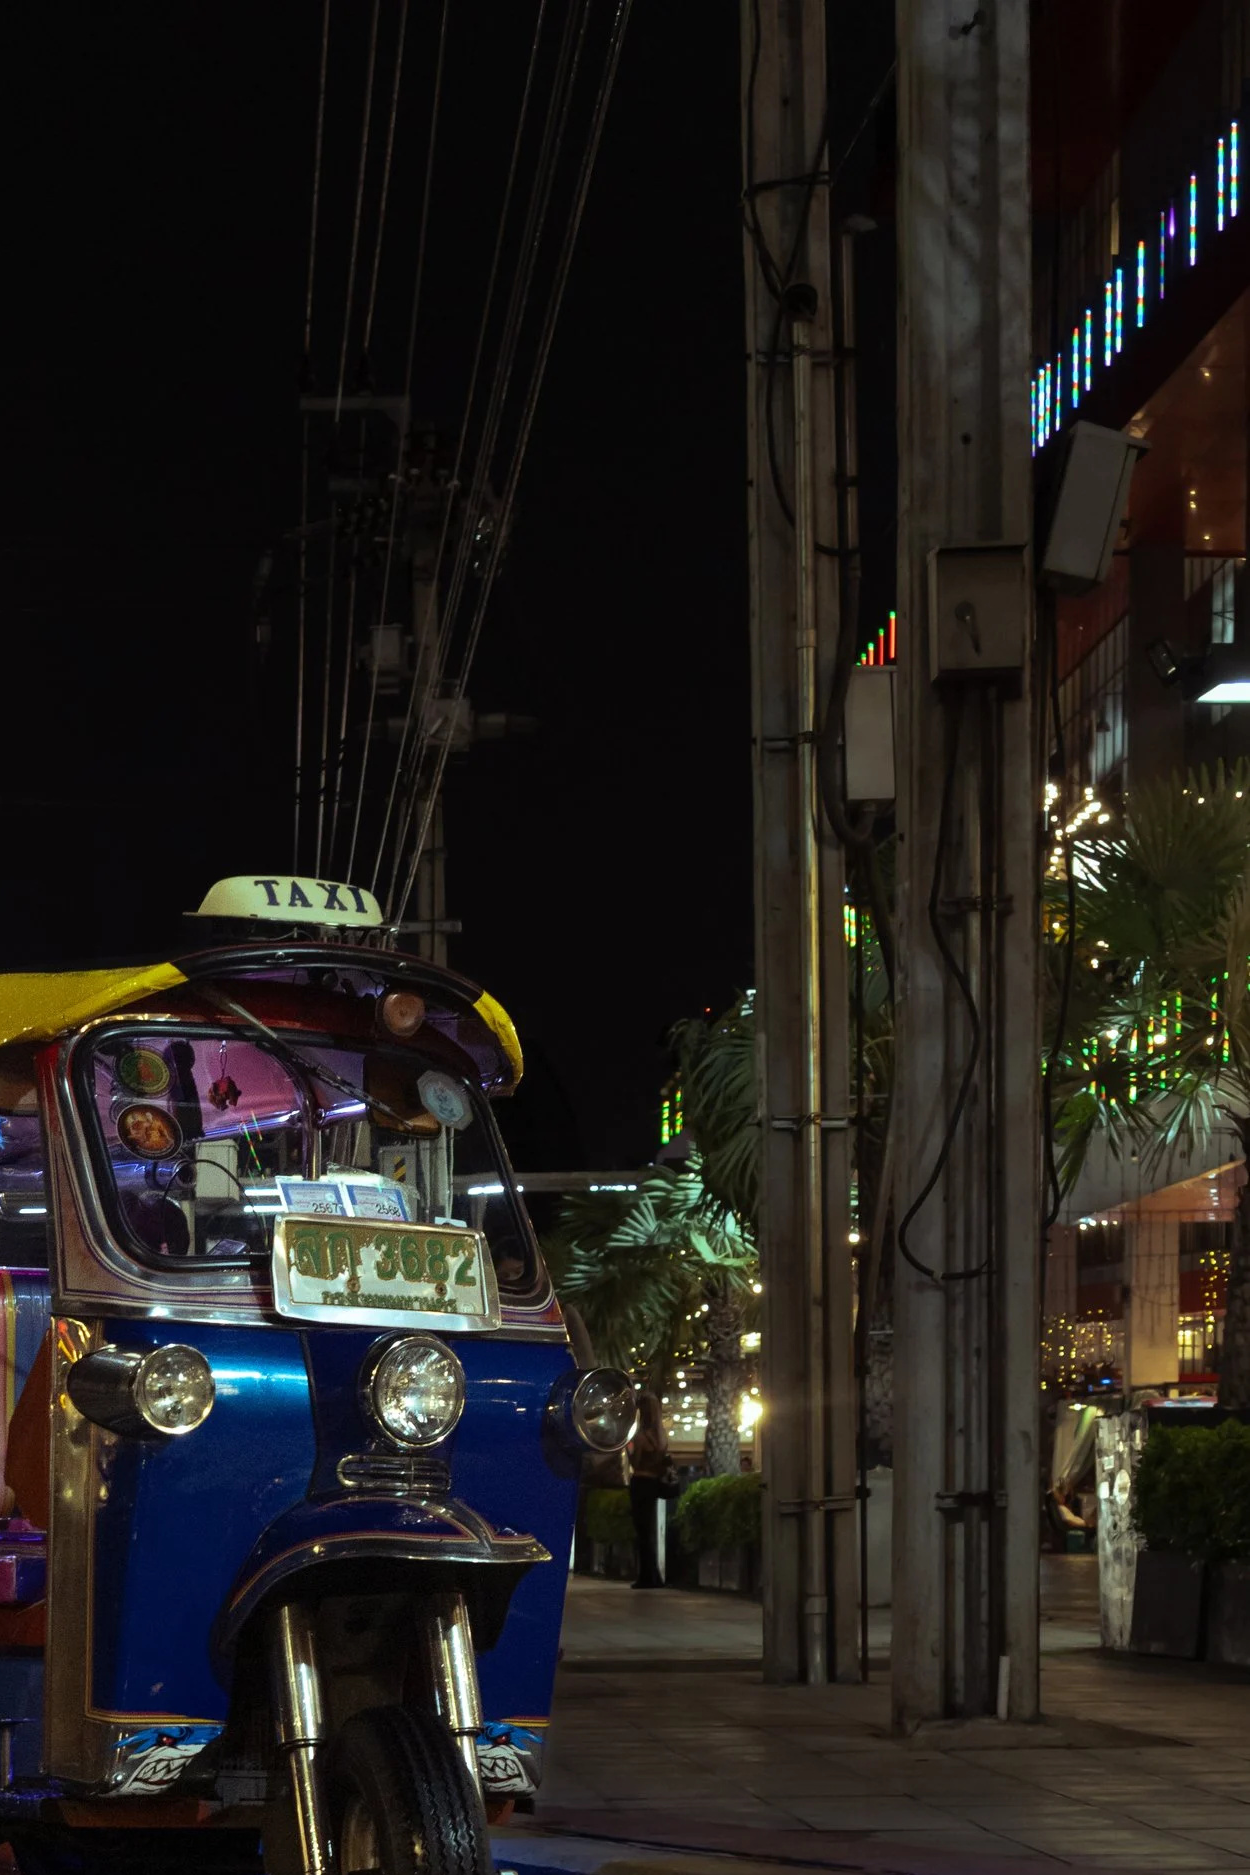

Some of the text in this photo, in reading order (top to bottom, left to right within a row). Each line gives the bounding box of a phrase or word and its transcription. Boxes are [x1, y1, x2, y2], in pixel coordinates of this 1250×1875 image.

[254, 879, 368, 913] TAXI
[312, 1202, 339, 1214] 2567
[373, 1233, 477, 1287] 3682
